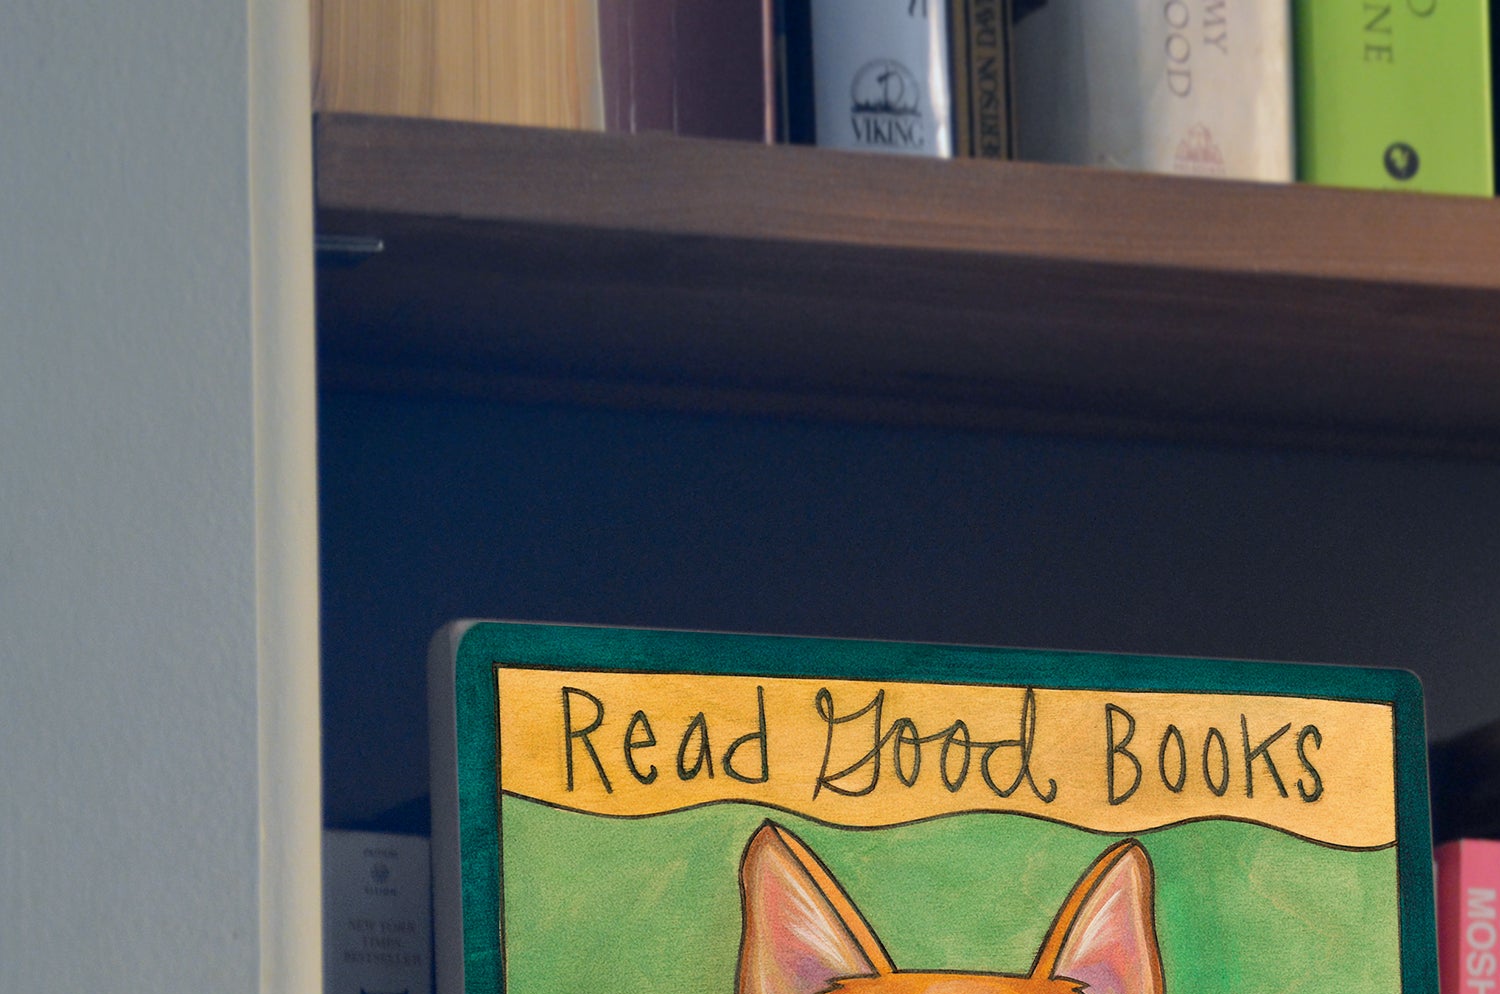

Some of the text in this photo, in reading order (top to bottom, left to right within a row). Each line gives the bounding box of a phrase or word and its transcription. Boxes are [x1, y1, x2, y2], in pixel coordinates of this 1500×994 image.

[1361, 1, 1396, 66] NE
[850, 118, 925, 148] VIKING
[561, 685, 771, 794] Read
[812, 685, 1057, 805] Good
